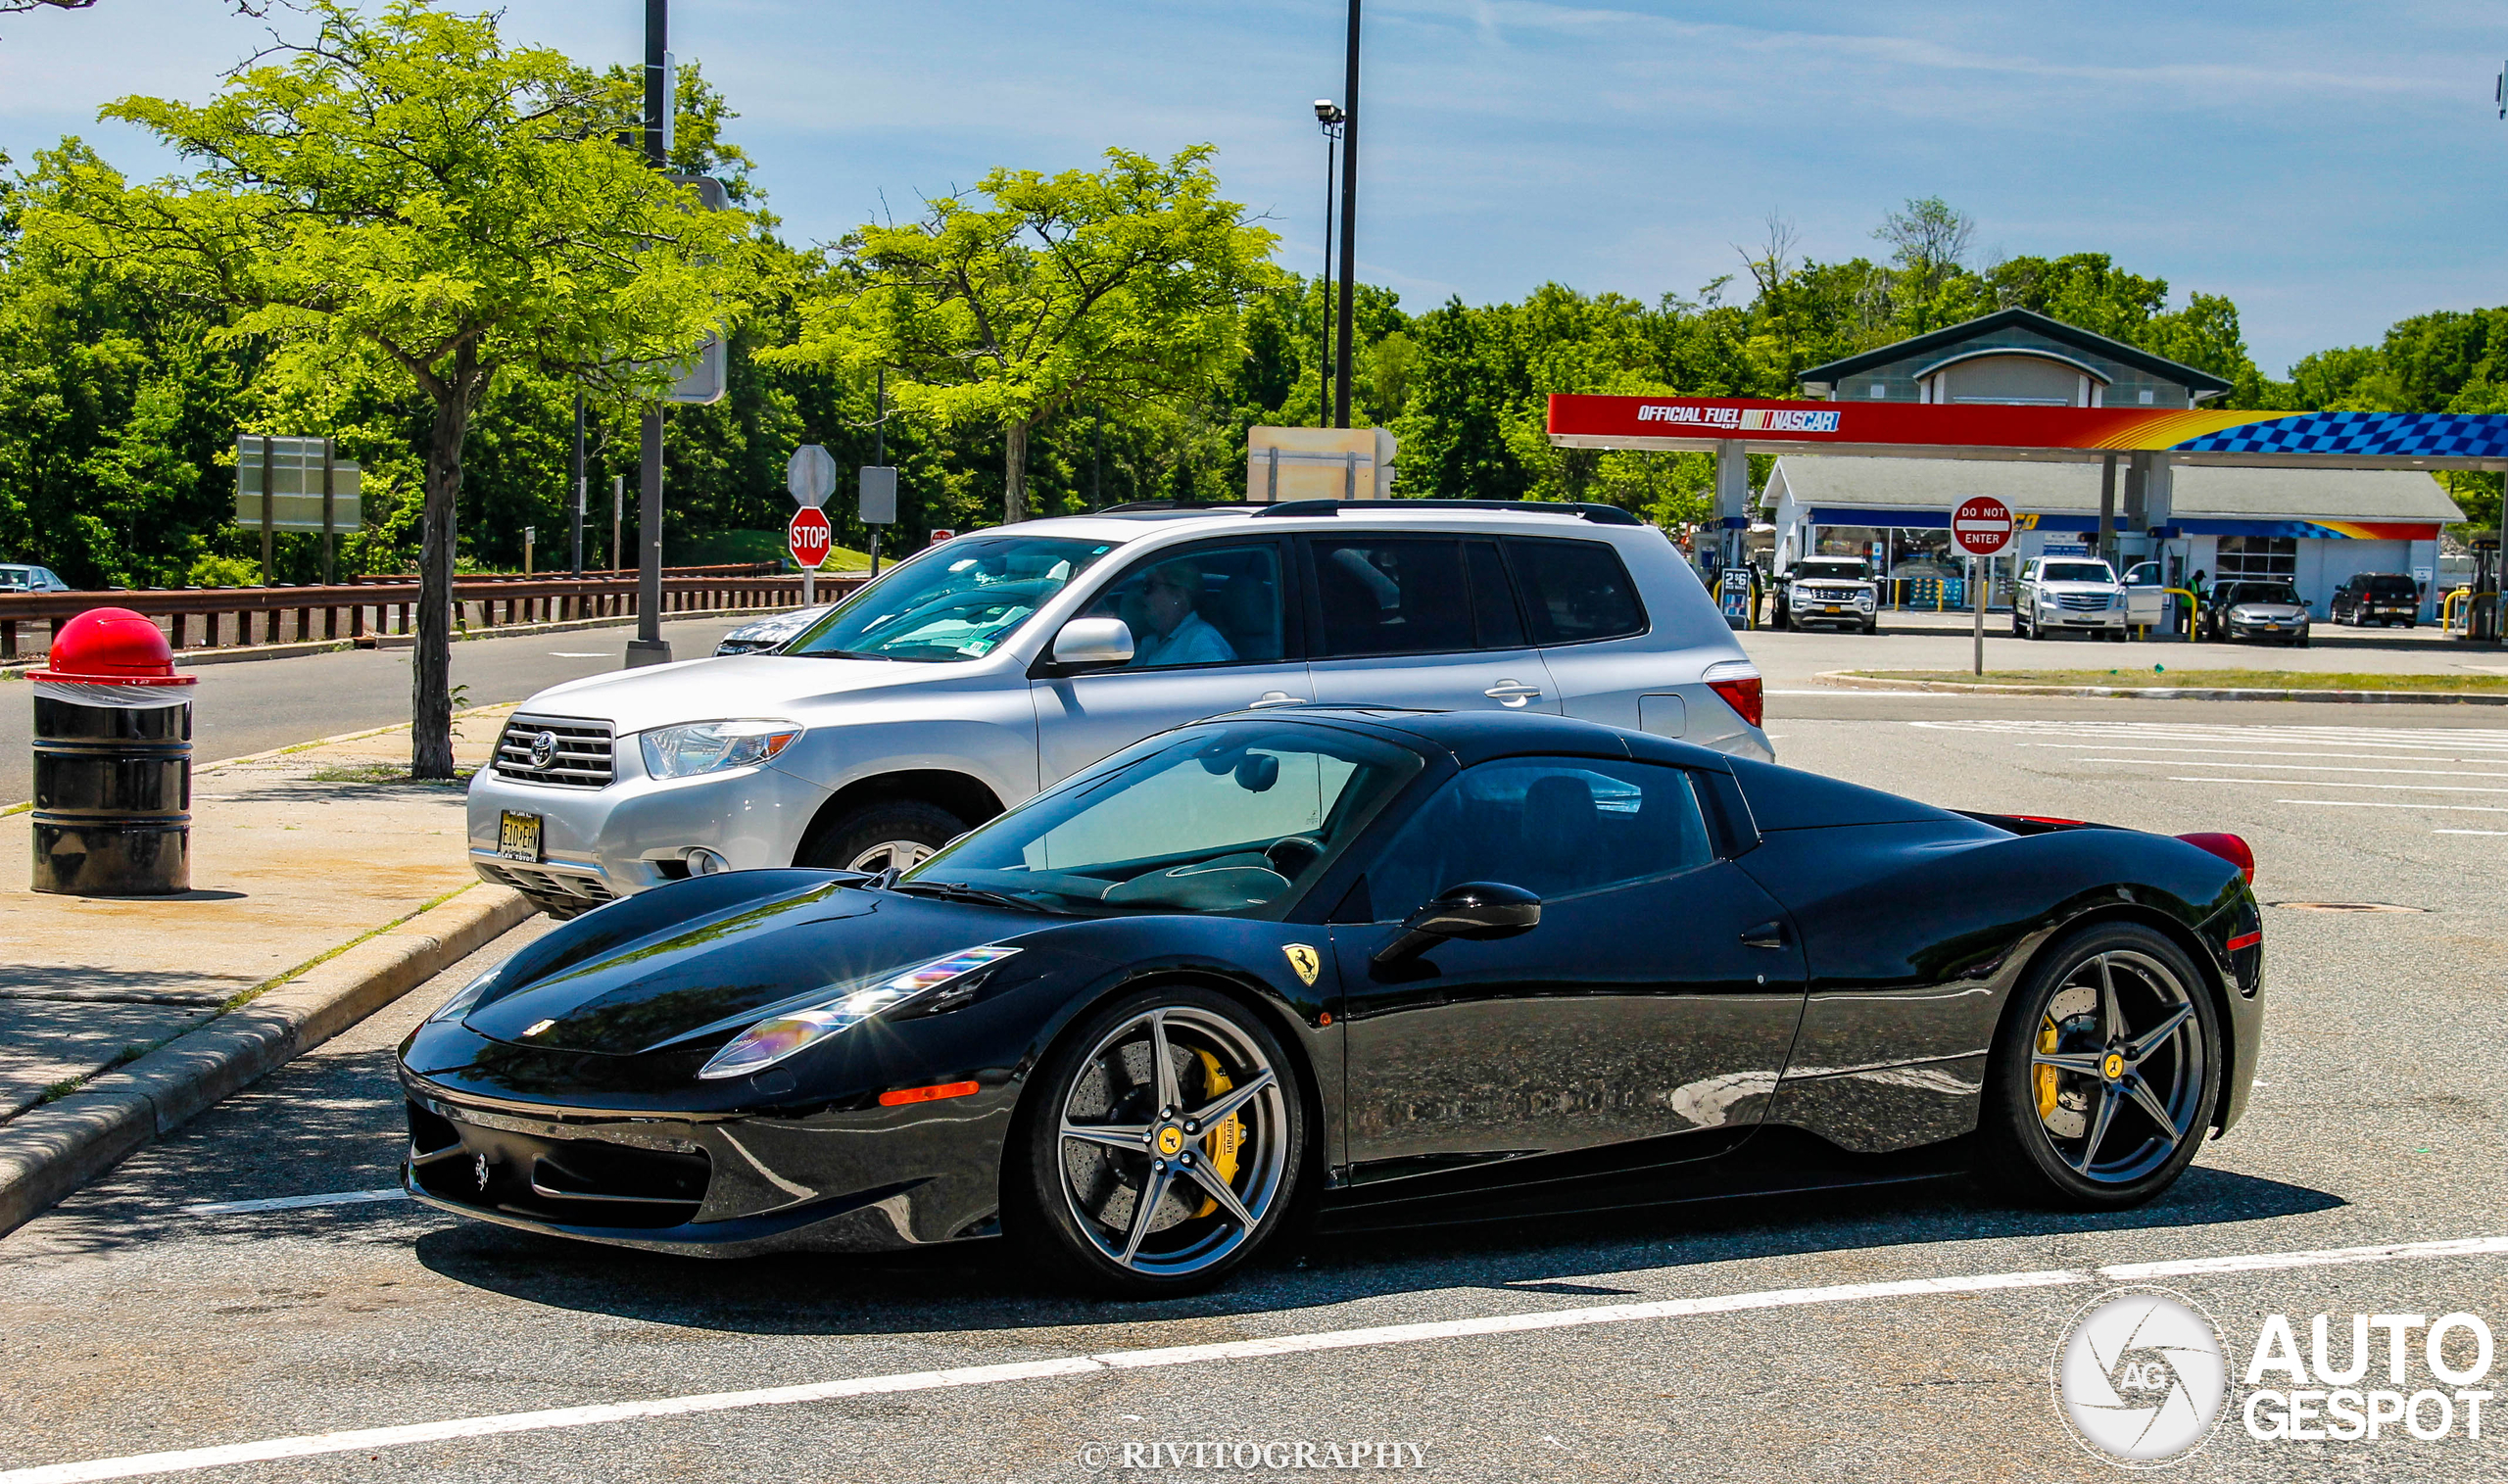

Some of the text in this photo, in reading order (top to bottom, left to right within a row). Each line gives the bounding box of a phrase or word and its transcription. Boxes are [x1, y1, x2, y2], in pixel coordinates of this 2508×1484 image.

[1637, 405, 1740, 423] OFFICIAL FUEL
[1769, 410, 1838, 432] NASCAR
[1961, 507, 2005, 517] DO NOT
[793, 525, 829, 550] STOP
[1964, 533, 2000, 544] ENTER
[514, 854, 537, 863] TOYOTA
